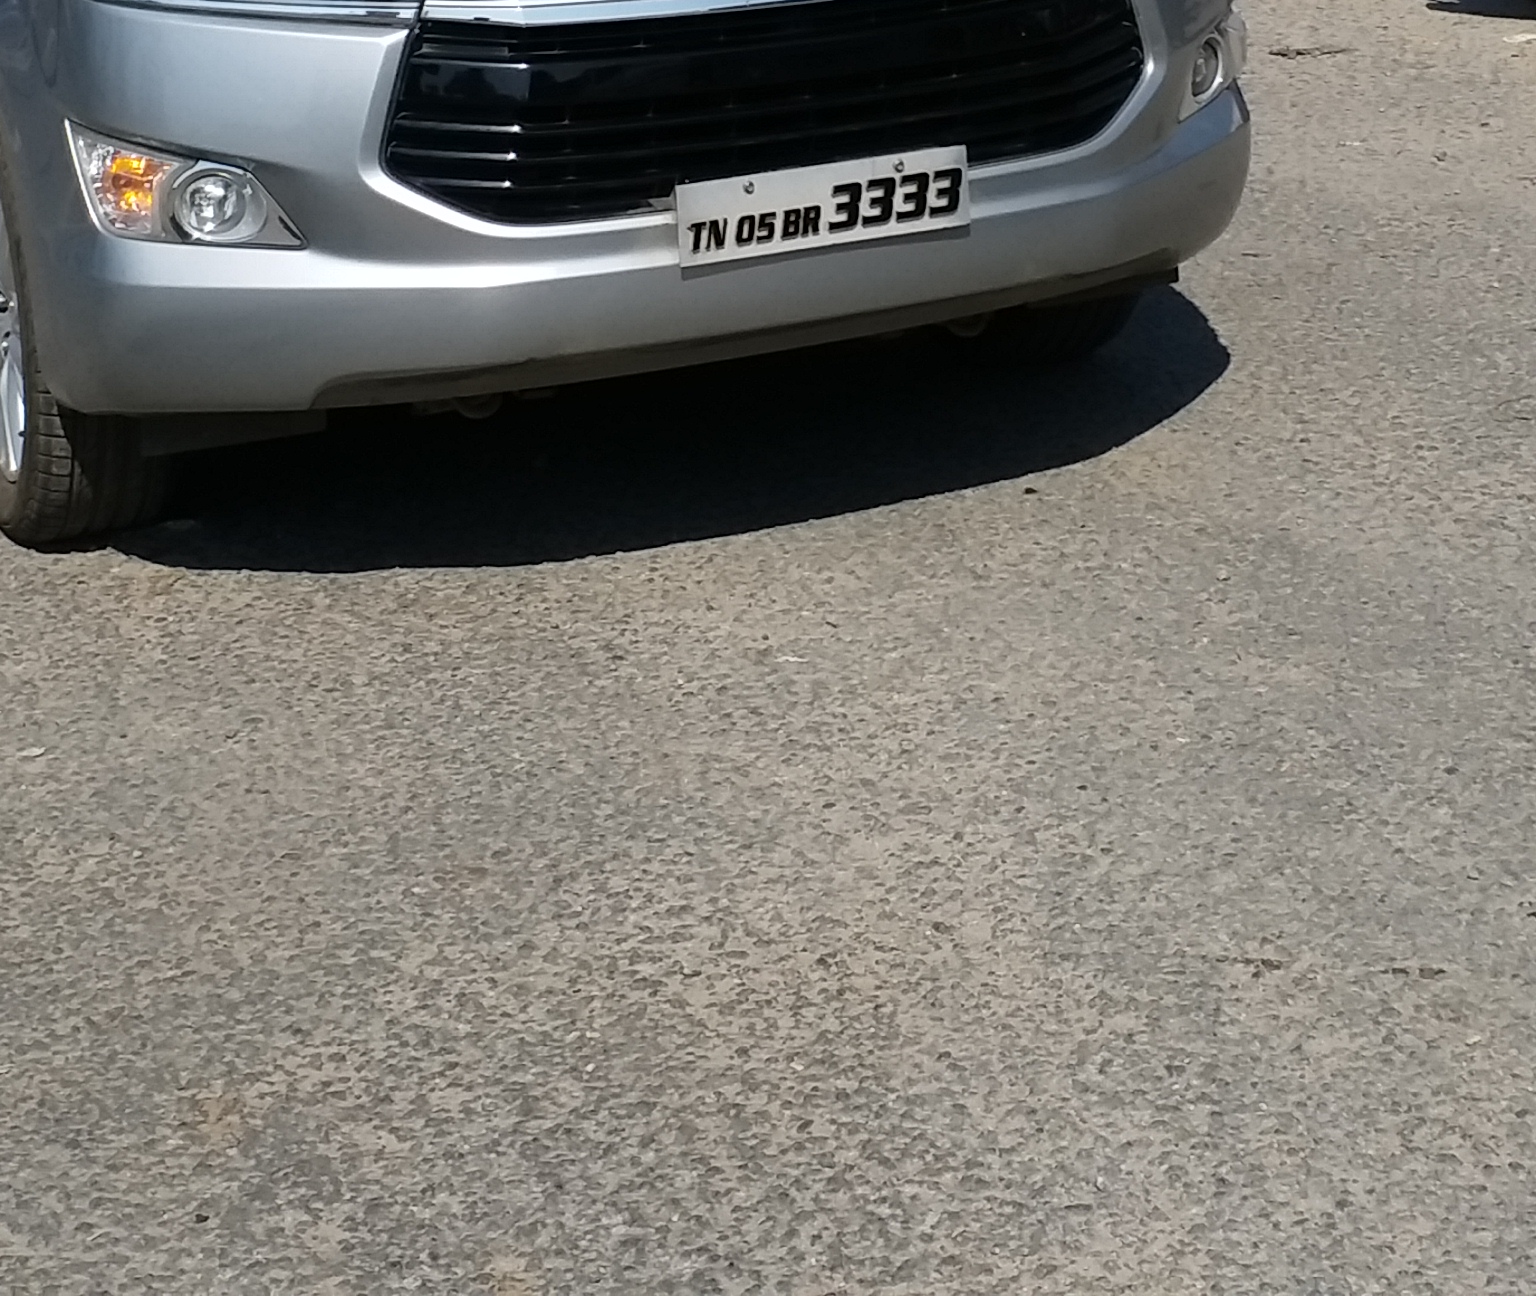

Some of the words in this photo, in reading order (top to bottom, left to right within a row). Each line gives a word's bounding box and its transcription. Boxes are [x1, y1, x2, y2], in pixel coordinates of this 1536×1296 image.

[688, 218, 728, 254] TN
[735, 211, 777, 247] 05
[781, 205, 822, 242] BR
[828, 168, 963, 234] 3333
